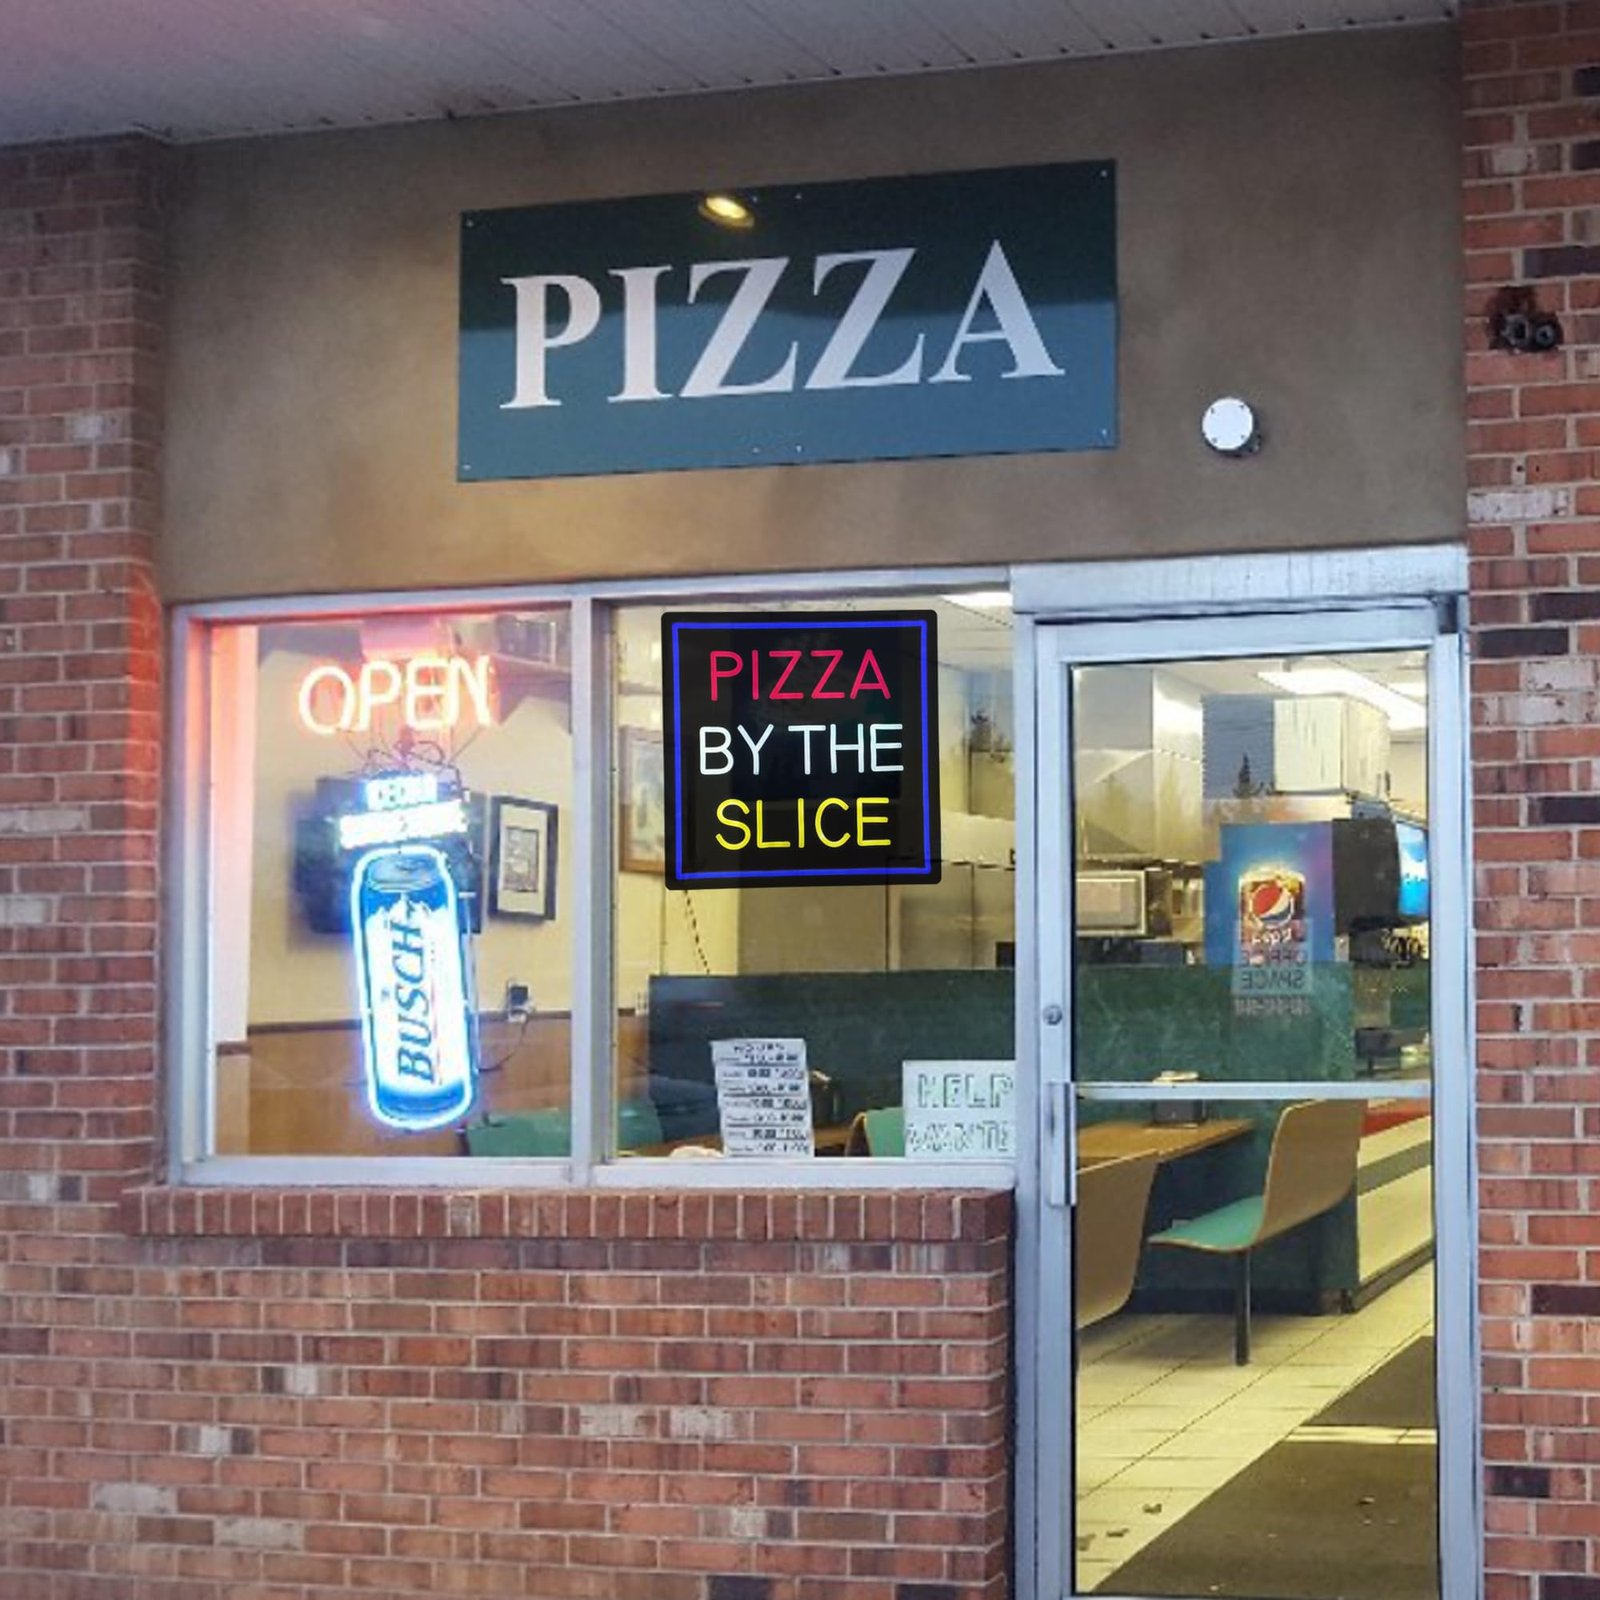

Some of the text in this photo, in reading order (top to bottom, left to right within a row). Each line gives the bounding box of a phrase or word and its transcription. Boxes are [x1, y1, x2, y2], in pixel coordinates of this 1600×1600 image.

[500, 239, 1065, 409] PIZZA
[298, 654, 492, 735] OPEN
[710, 649, 891, 701] PIZZA
[699, 723, 904, 775] BY THE
[716, 798, 891, 850] SLICE
[389, 920, 435, 1084] BUSCH
[917, 1073, 1014, 1109] HELP
